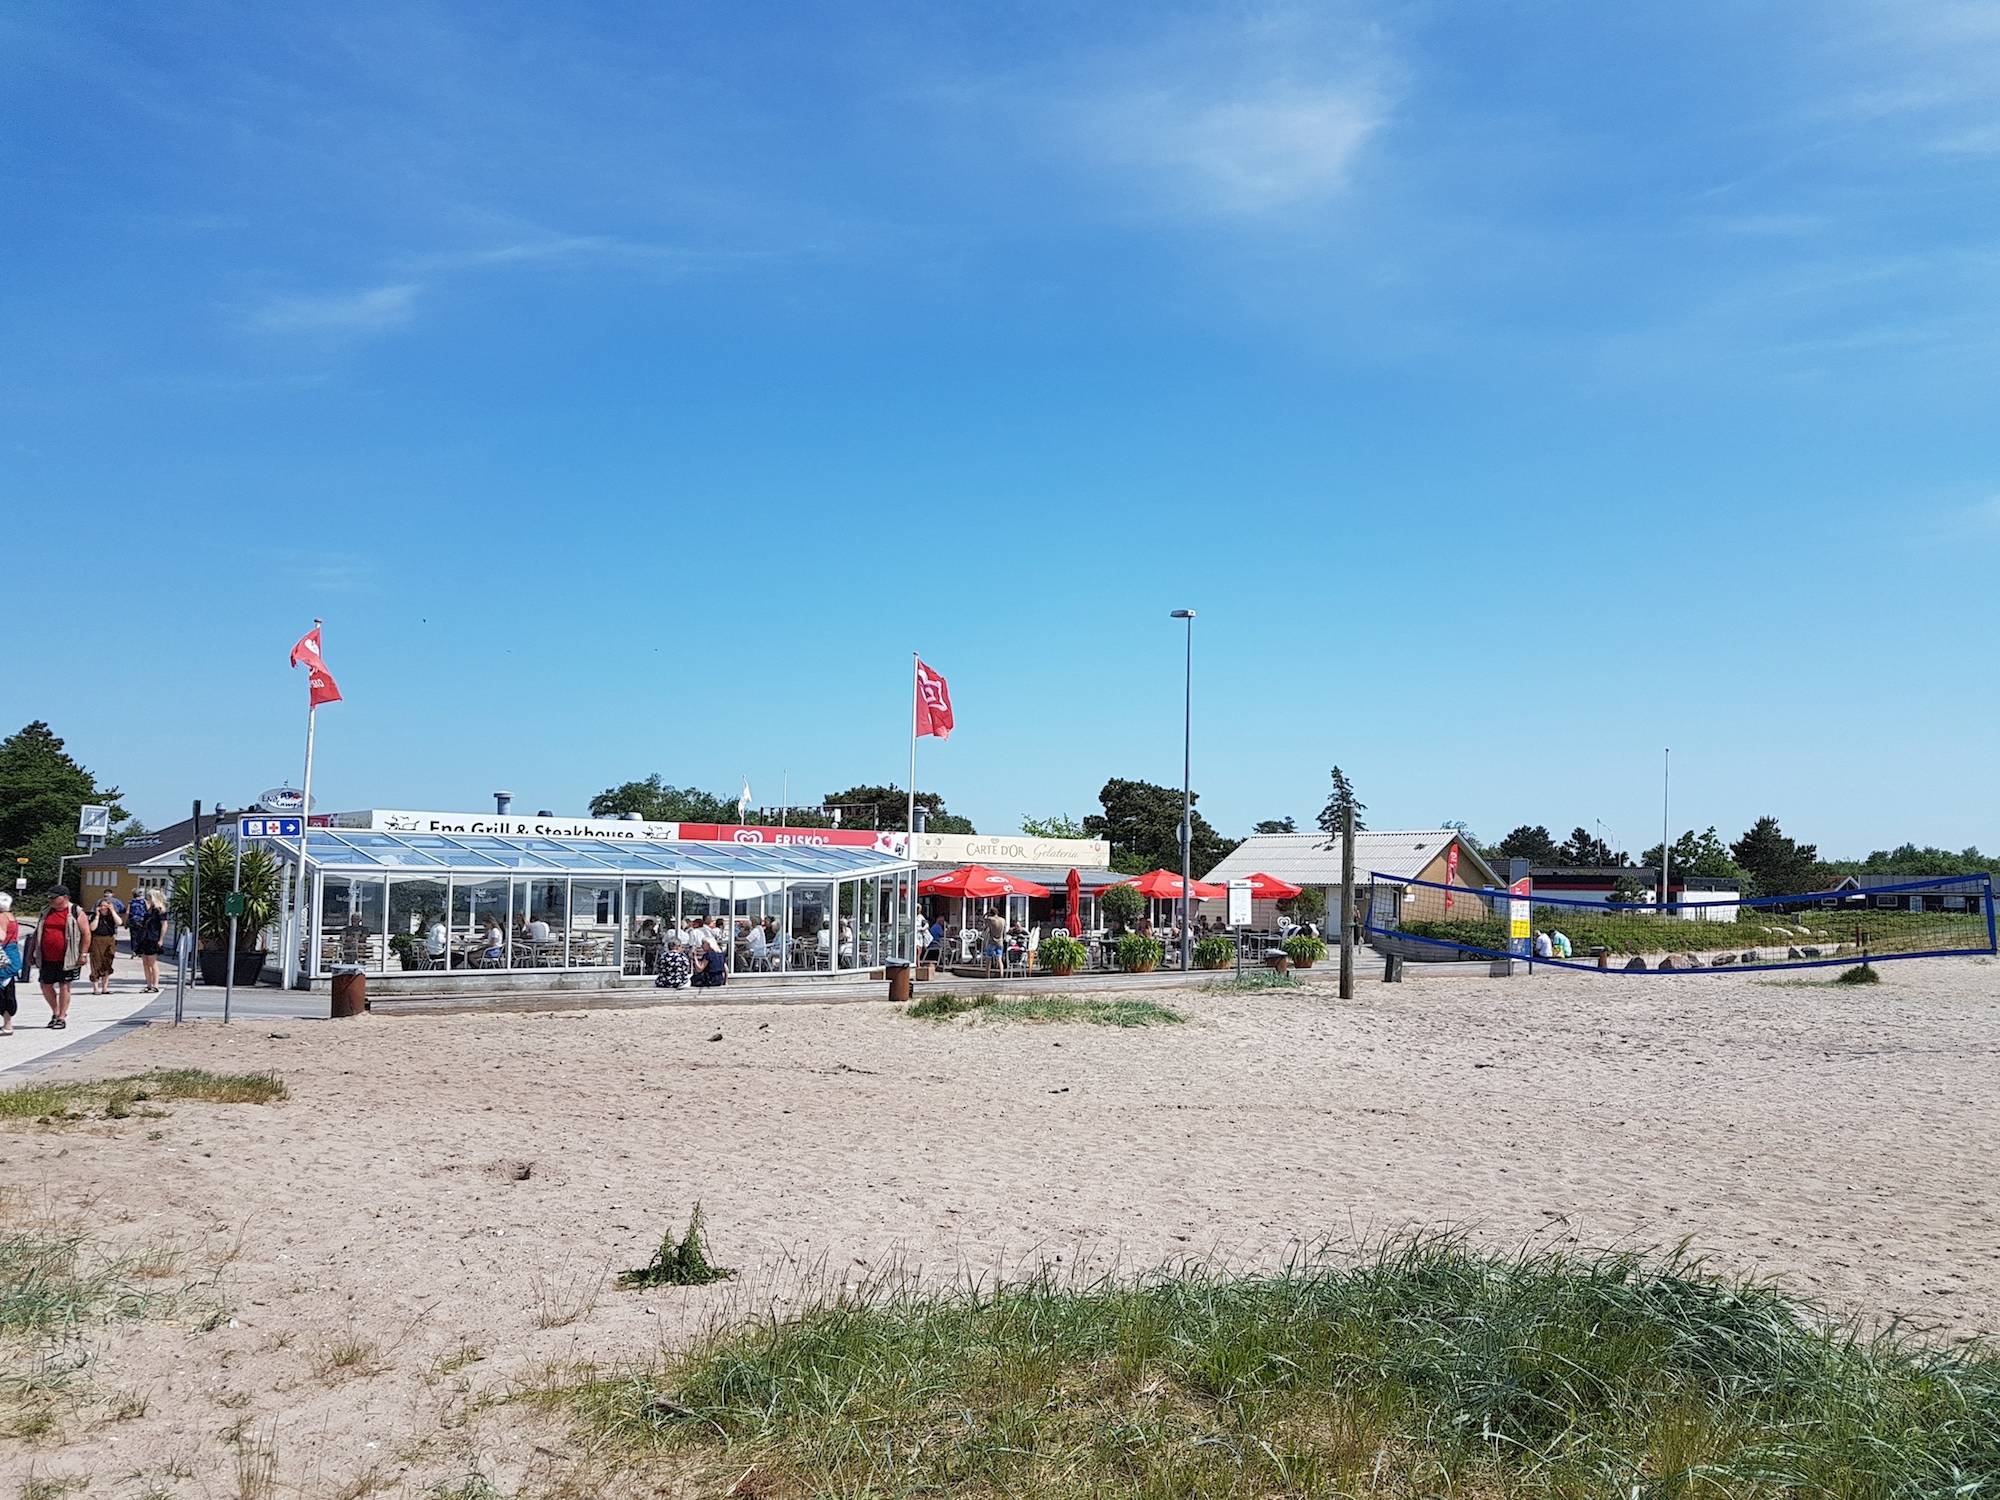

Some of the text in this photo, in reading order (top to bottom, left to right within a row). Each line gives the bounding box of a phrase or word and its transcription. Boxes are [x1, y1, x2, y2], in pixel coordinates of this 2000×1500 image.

[471, 822, 510, 834] Grill
[516, 824, 529, 834] &
[534, 825, 634, 838] Steakhouse
[1033, 844, 1080, 861] Gelateria
